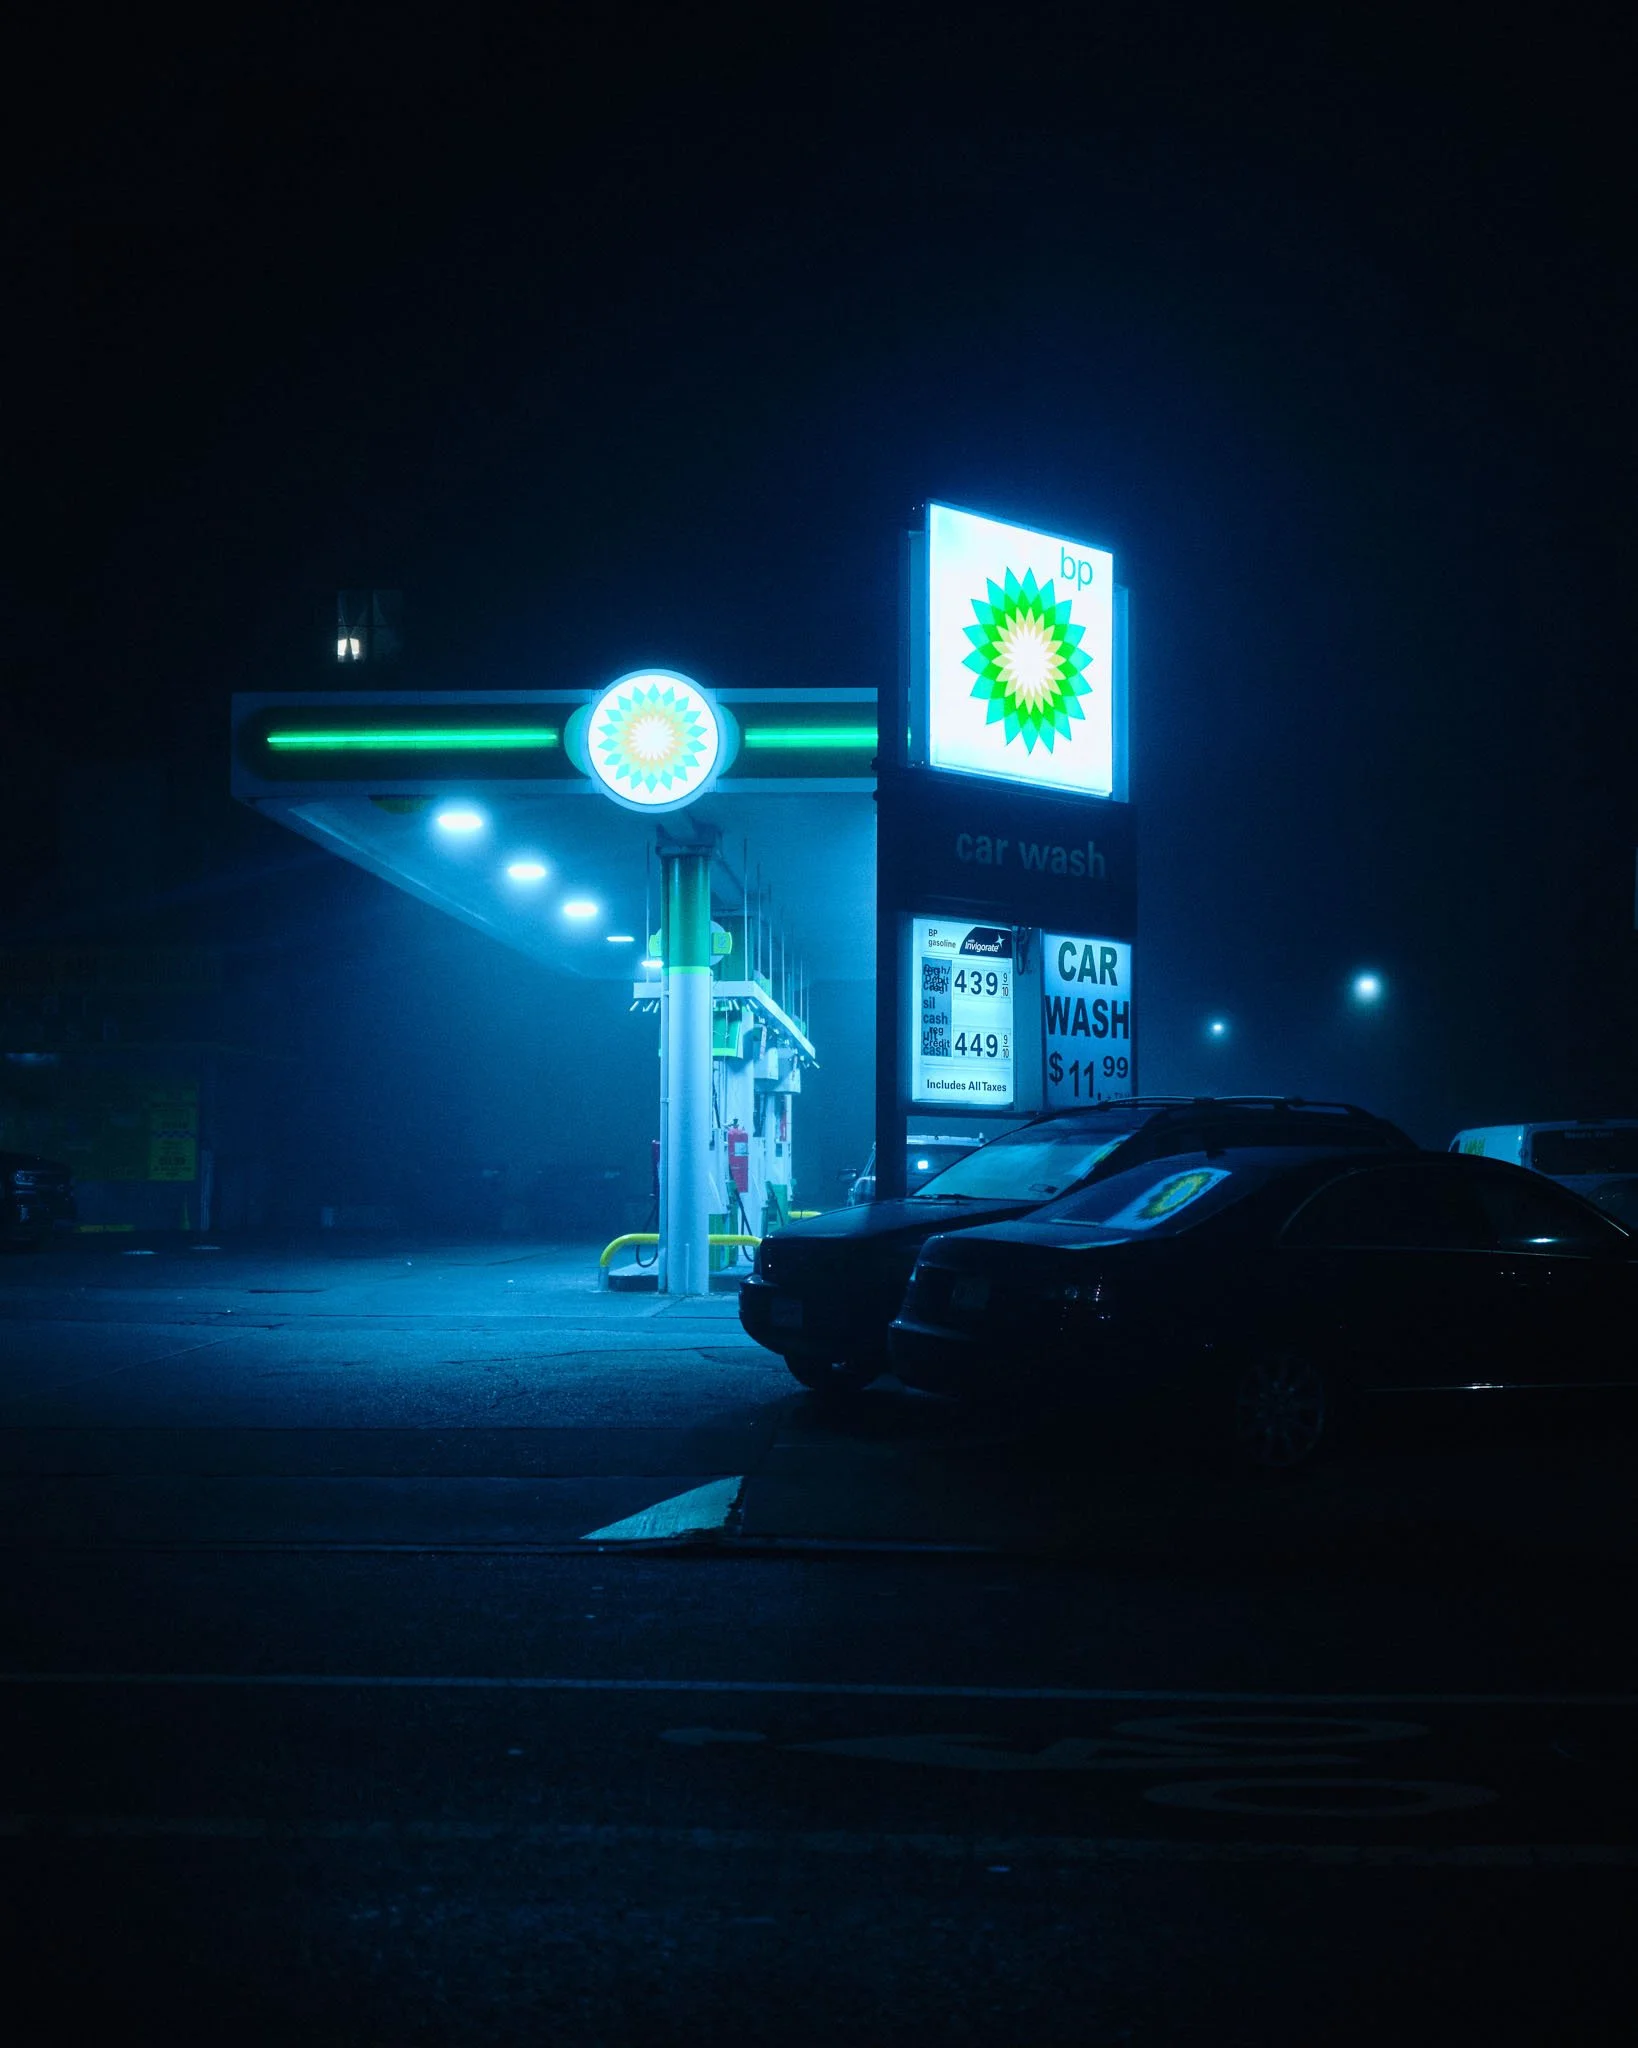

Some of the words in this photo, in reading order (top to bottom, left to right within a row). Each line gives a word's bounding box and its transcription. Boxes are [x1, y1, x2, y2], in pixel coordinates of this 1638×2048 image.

[1060, 546, 1093, 591] bp
[956, 832, 1008, 866] car
[1019, 840, 1106, 879] wash
[928, 928, 938, 937] BP
[928, 938, 957, 949] gasoline
[1057, 941, 1118, 986] CAR
[923, 997, 936, 1009] sil
[923, 1012, 948, 1025] cash
[1044, 994, 1129, 1039] WASH
[926, 1079, 966, 1091] Includes
[968, 1080, 981, 1091] All
[982, 1081, 1007, 1092] Taxes
